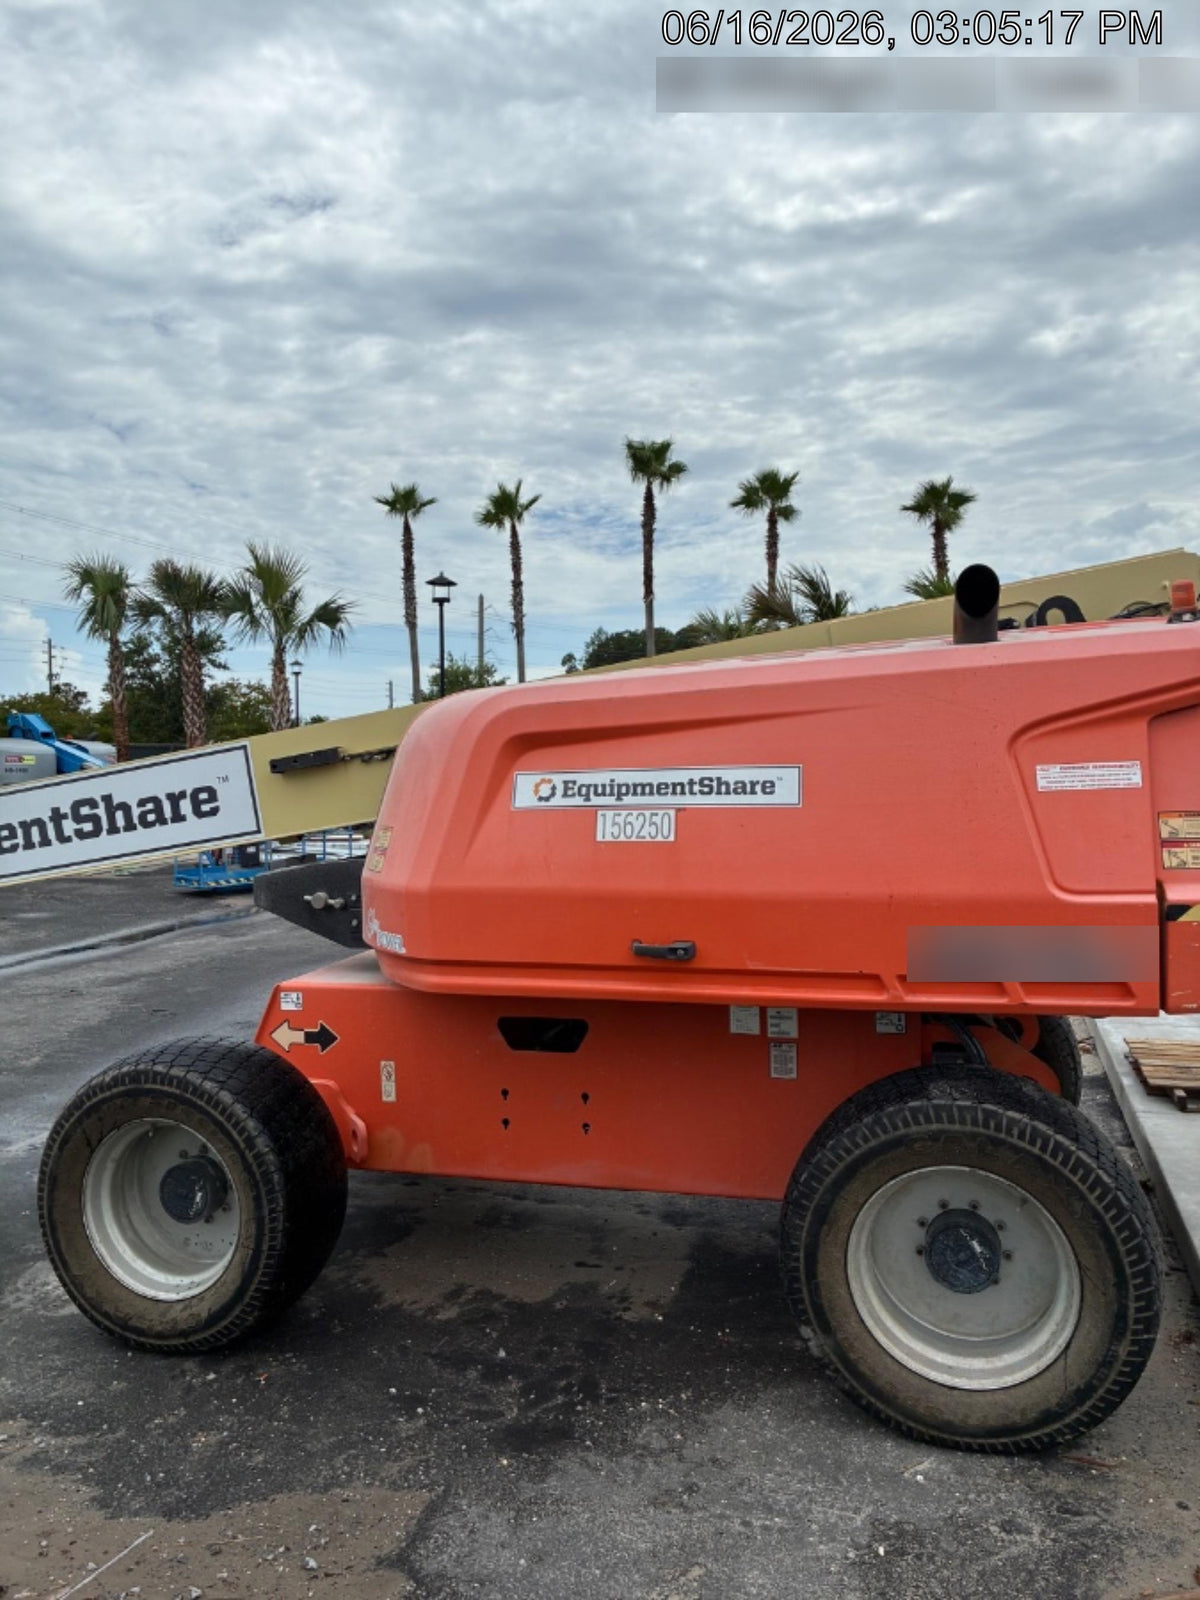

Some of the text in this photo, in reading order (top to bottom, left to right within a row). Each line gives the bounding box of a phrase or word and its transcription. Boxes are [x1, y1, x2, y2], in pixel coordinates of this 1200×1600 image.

[561, 776, 776, 801] EquipmentShare
[0, 785, 220, 855] entShare
[599, 811, 672, 840] 156250
